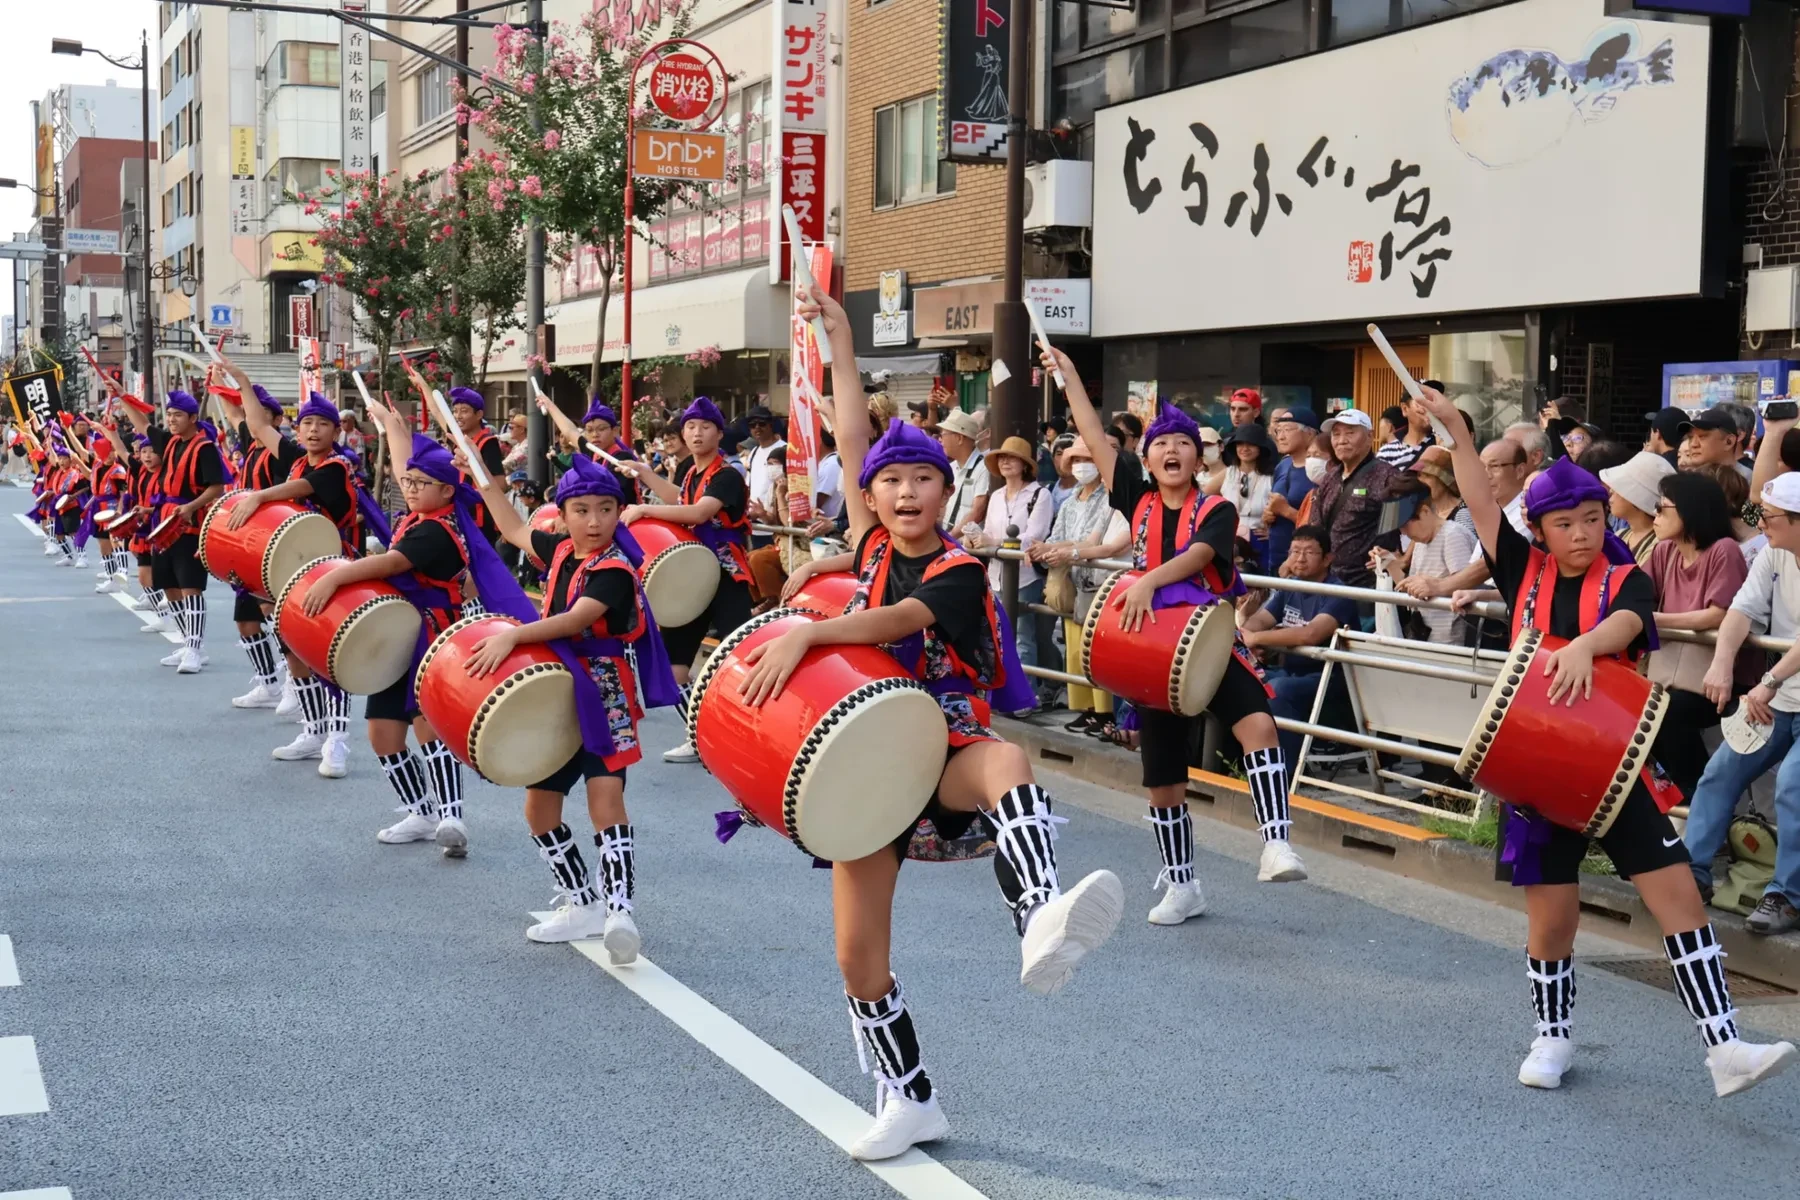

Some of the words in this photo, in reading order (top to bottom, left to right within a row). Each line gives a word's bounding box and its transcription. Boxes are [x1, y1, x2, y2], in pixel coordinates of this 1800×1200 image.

[661, 60, 676, 69] FIRE
[676, 62, 705, 72] HYDRANT
[815, 12, 827, 98] ファッション市場
[348, 32, 364, 141] 香港本格飲茶
[655, 71, 710, 102] 消火栓
[784, 25, 816, 121] サンキ
[952, 123, 987, 144] 2F
[648, 135, 716, 163] bnb+
[657, 164, 700, 176] HOSTEL
[945, 304, 980, 330] EAST
[1044, 305, 1076, 319] EAST
